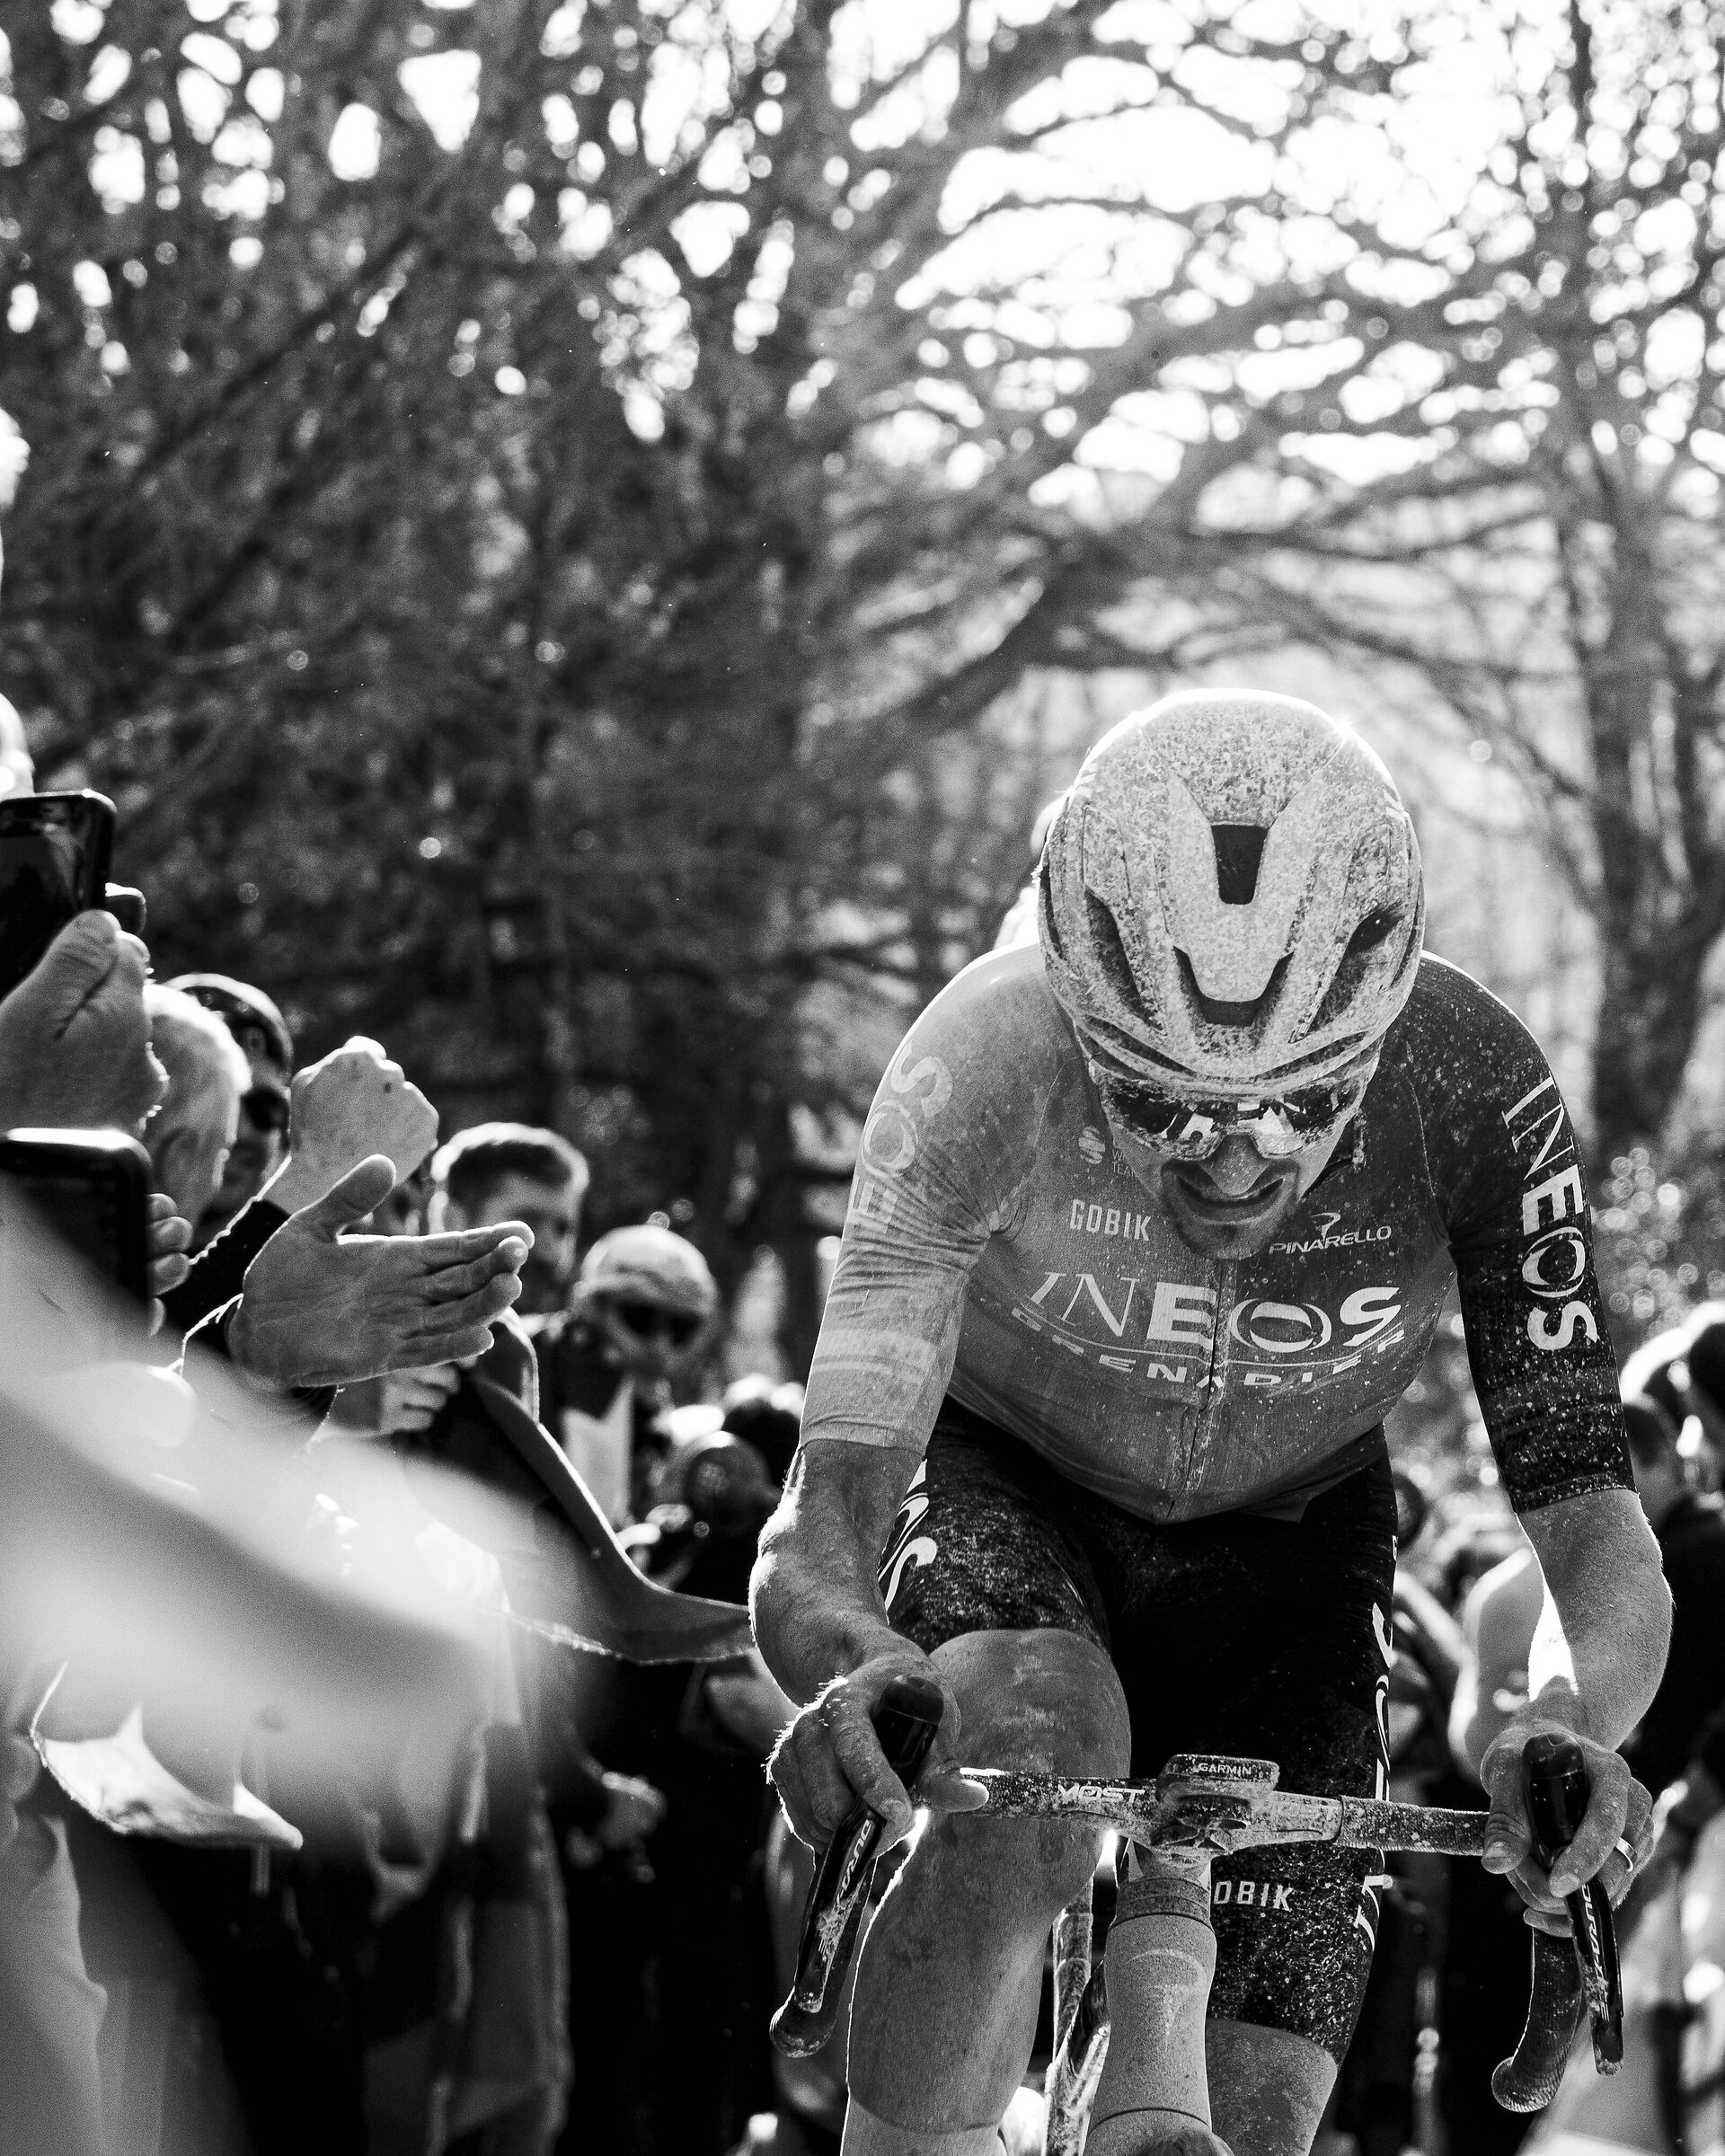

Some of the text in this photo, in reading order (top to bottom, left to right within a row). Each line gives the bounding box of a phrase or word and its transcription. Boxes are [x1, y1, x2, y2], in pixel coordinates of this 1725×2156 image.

[1069, 1198, 1151, 1241] GOBIK
[1502, 1071, 1598, 1351] INEOS
[1268, 1225, 1392, 1255] PINARELLO
[1024, 1272, 1402, 1353] INEOS
[1198, 1763, 1252, 1777] GARMIN
[1213, 1880, 1294, 1913] OBIK
